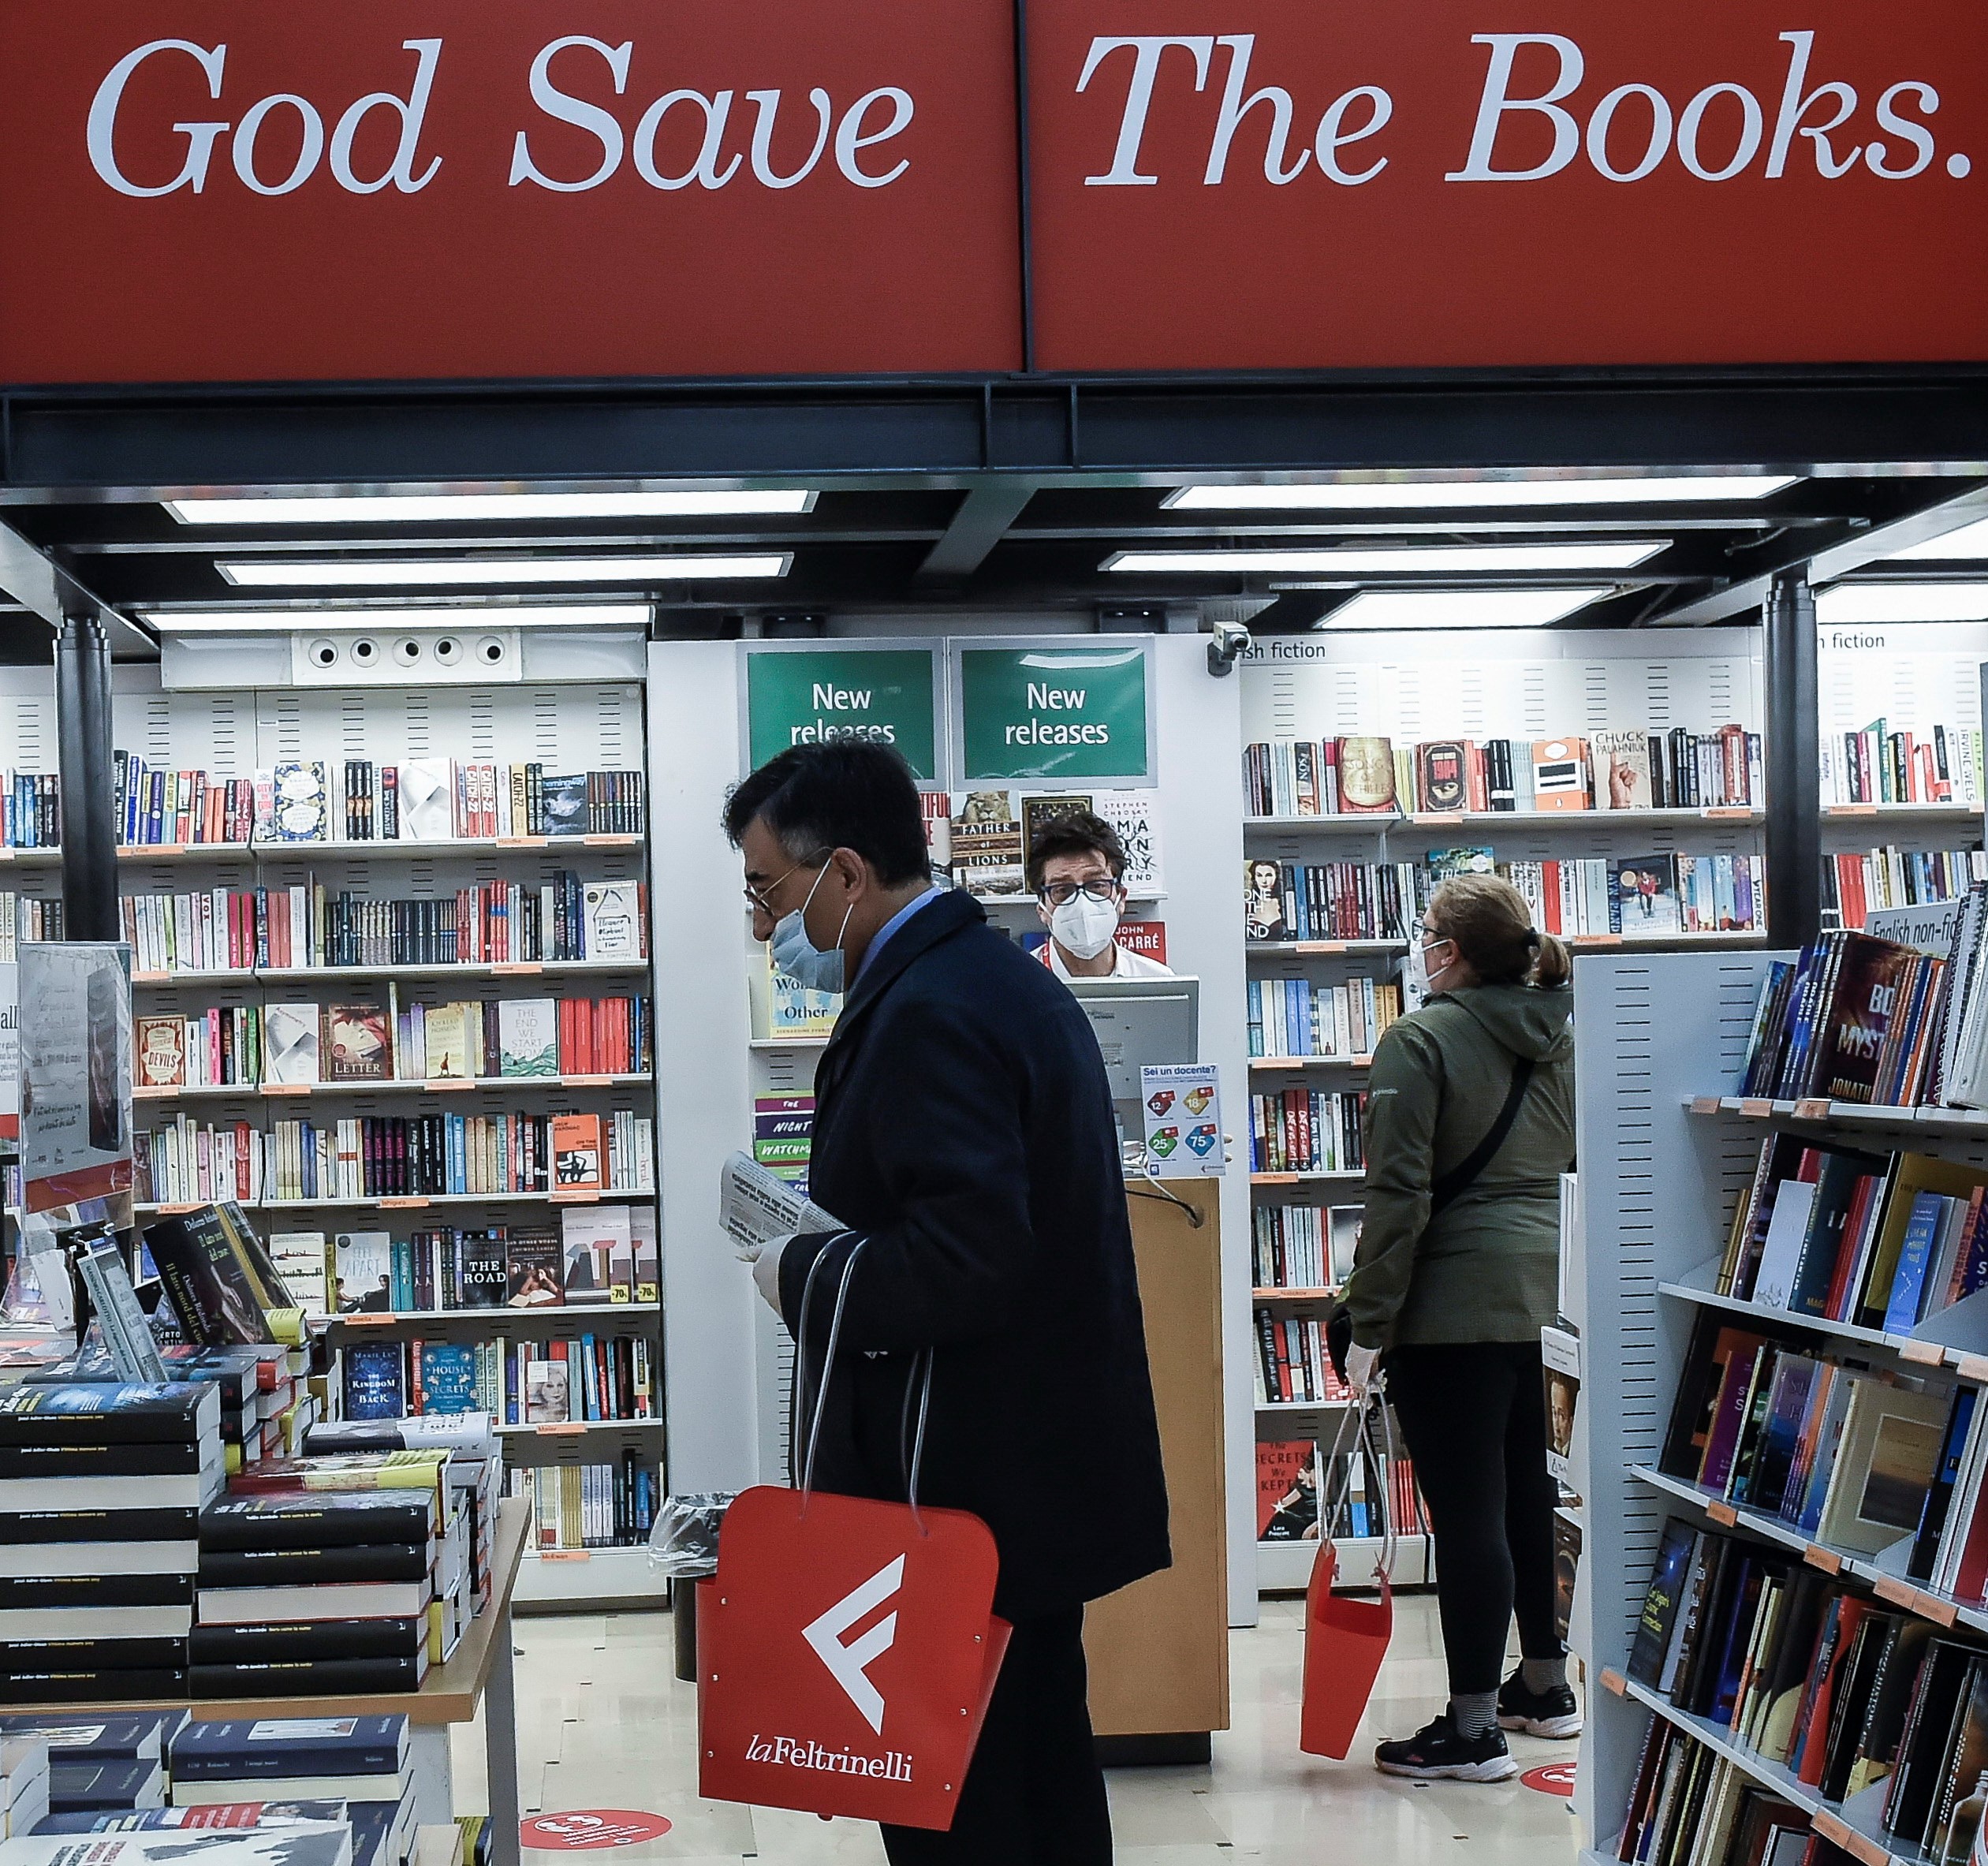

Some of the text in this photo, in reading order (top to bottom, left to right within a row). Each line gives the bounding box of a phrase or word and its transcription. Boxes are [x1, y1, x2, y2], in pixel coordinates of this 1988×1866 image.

[1076, 31, 1971, 188] The Books.
[87, 35, 916, 198] God Save
[1833, 633, 1885, 648] fiction
[1270, 641, 1326, 659] fiction
[812, 683, 871, 710] New
[1028, 682, 1086, 710] New
[790, 722, 895, 746] releases
[1005, 718, 1110, 745] releases
[1595, 731, 1644, 743] CHUCK
[1595, 743, 1647, 755] PALAHNIUK
[1960, 729, 1972, 766] IRVINE
[1298, 758, 1307, 779] SON
[467, 770, 479, 813] CATCH-22
[481, 770, 493, 812] CATCH-22
[513, 772, 524, 807] CATCH-22
[962, 823, 1011, 834] FATHER
[968, 855, 1008, 866] LIONS
[1608, 873, 1620, 932] AYN RAND
[517, 1009, 537, 1018] THE
[784, 1006, 828, 1020] Other
[515, 1019, 539, 1028] END
[520, 1028, 535, 1038] WE
[511, 1038, 543, 1047] START
[147, 1051, 177, 1067] DEVILS
[512, 1048, 542, 1058] FROM
[335, 1063, 382, 1073] LETTER
[1143, 1067, 1158, 1077] Sei
[1173, 1065, 1217, 1075] docente?
[1828, 1077, 1873, 1098] JONATH
[773, 1120, 812, 1133] NIGHT
[1152, 1139, 1168, 1150] 25
[1190, 1135, 1206, 1147] 75
[468, 1260, 500, 1272] THE
[464, 1271, 507, 1284] ROAD
[176, 1290, 193, 1312] nord
[187, 1312, 200, 1328] del
[182, 1274, 211, 1334] Dolores Redondo
[431, 1365, 466, 1375] HOUSE
[352, 1379, 396, 1390] KINGDOM
[429, 1384, 470, 1394] SECRETS
[359, 1393, 390, 1405] BACK
[1257, 1452, 1305, 1465] SECRETS
[744, 1734, 913, 1782] laFeltrinelli
